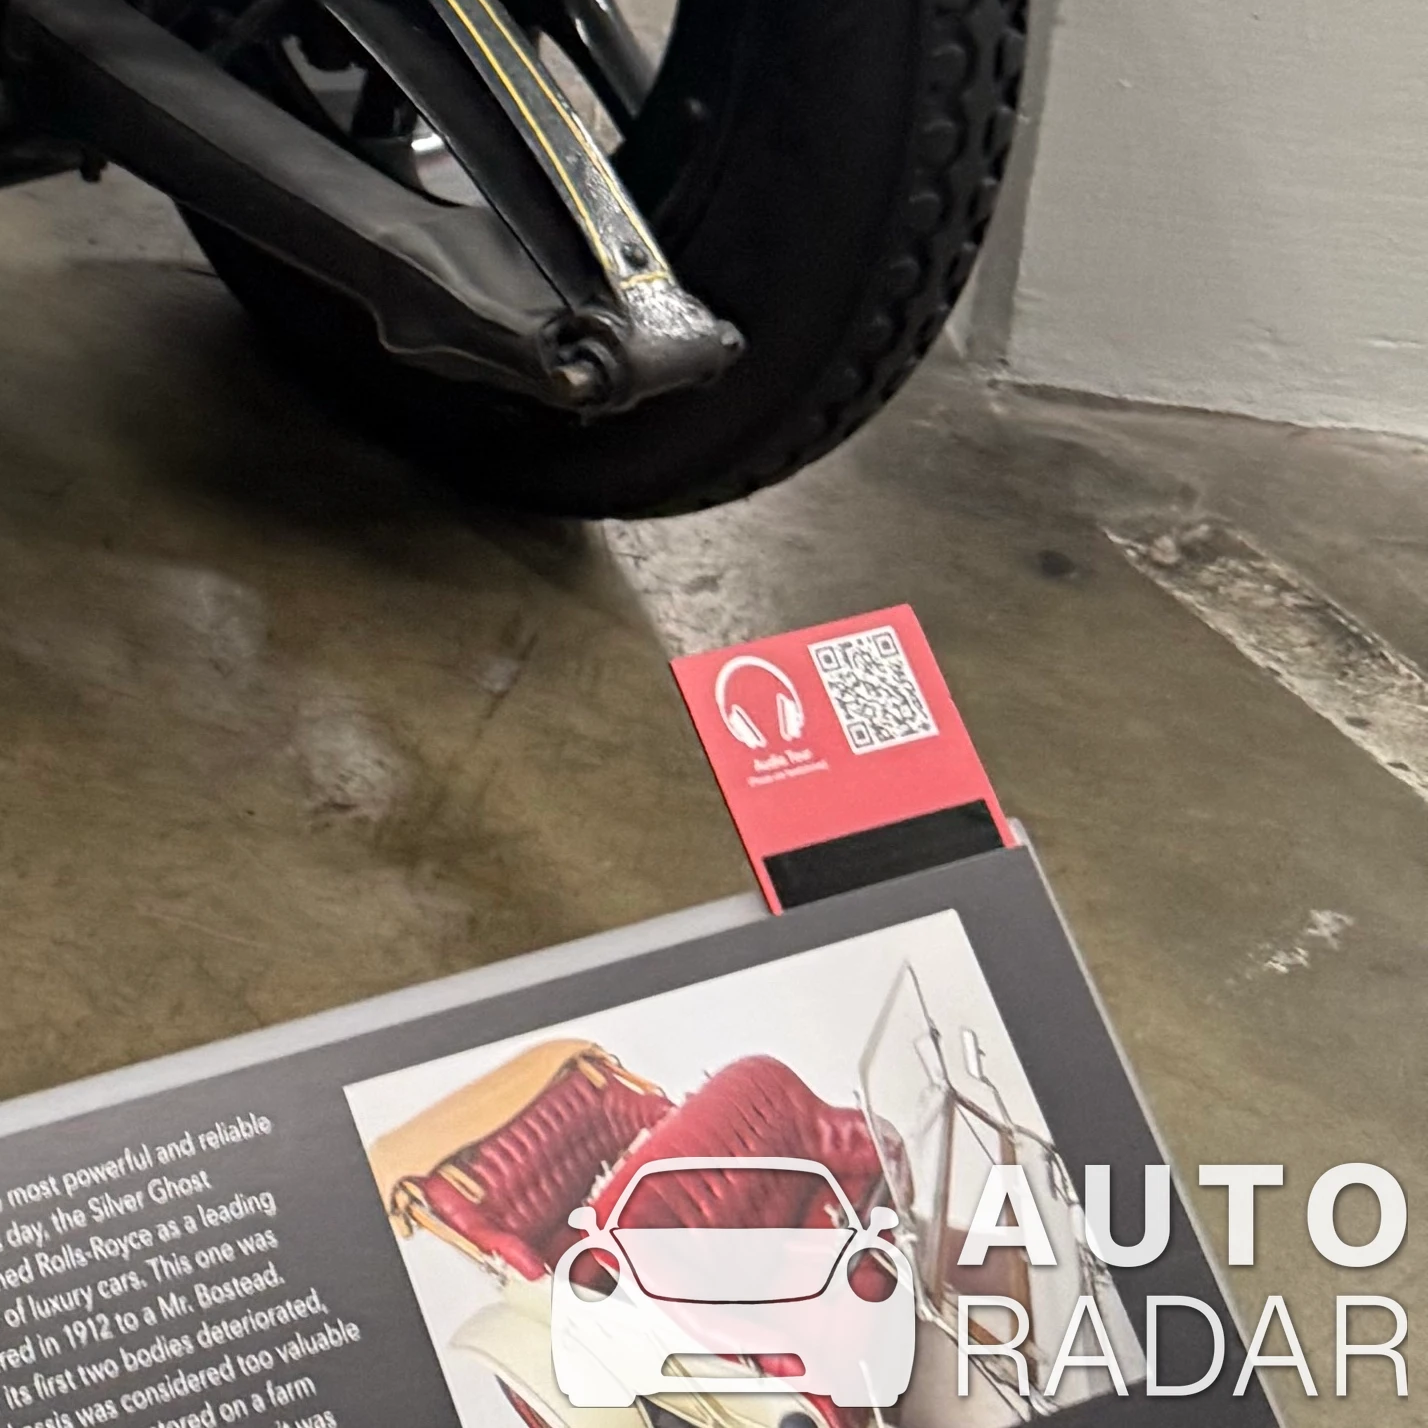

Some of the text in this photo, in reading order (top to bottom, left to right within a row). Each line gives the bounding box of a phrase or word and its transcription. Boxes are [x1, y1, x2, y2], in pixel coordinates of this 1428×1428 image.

[7, 1176, 61, 1207] most
[63, 1144, 153, 1197] powerful
[156, 1131, 195, 1164] and
[198, 1113, 271, 1150] reliable
[6, 1221, 49, 1247] day,
[51, 1207, 87, 1234] the
[88, 1191, 144, 1222] Silver
[148, 1171, 212, 1204] Ghost
[35, 1229, 153, 1277] Rolls-Royce
[156, 1220, 181, 1242] as
[183, 1216, 198, 1233] a
[197, 1192, 276, 1227] leading
[4, 1297, 27, 1327] of
[27, 1285, 92, 1320] luxury
[97, 1271, 147, 1299] cars.
[145, 1253, 192, 1282] This
[195, 1243, 235, 1268] one
[236, 1230, 278, 1255] was
[37, 1334, 61, 1358] in
[63, 1314, 113, 1349] 1912
[115, 1312, 139, 1334] to
[142, 1307, 157, 1325] a
[157, 1292, 194, 1319] Mr.
[194, 1261, 285, 1309] Bostead.
[3, 1385, 33, 1410] its
[34, 1369, 77, 1399] first
[77, 1359, 119, 1386] two
[120, 1335, 194, 1372] bodies
[197, 1288, 328, 1348] deteriorated,
[75, 1400, 118, 1427] was
[120, 1355, 236, 1413] considered
[237, 1350, 274, 1376] too
[275, 1318, 360, 1363] valuable
[219, 1399, 248, 1422] on
[251, 1394, 266, 1413] a
[266, 1377, 316, 1407] farm
